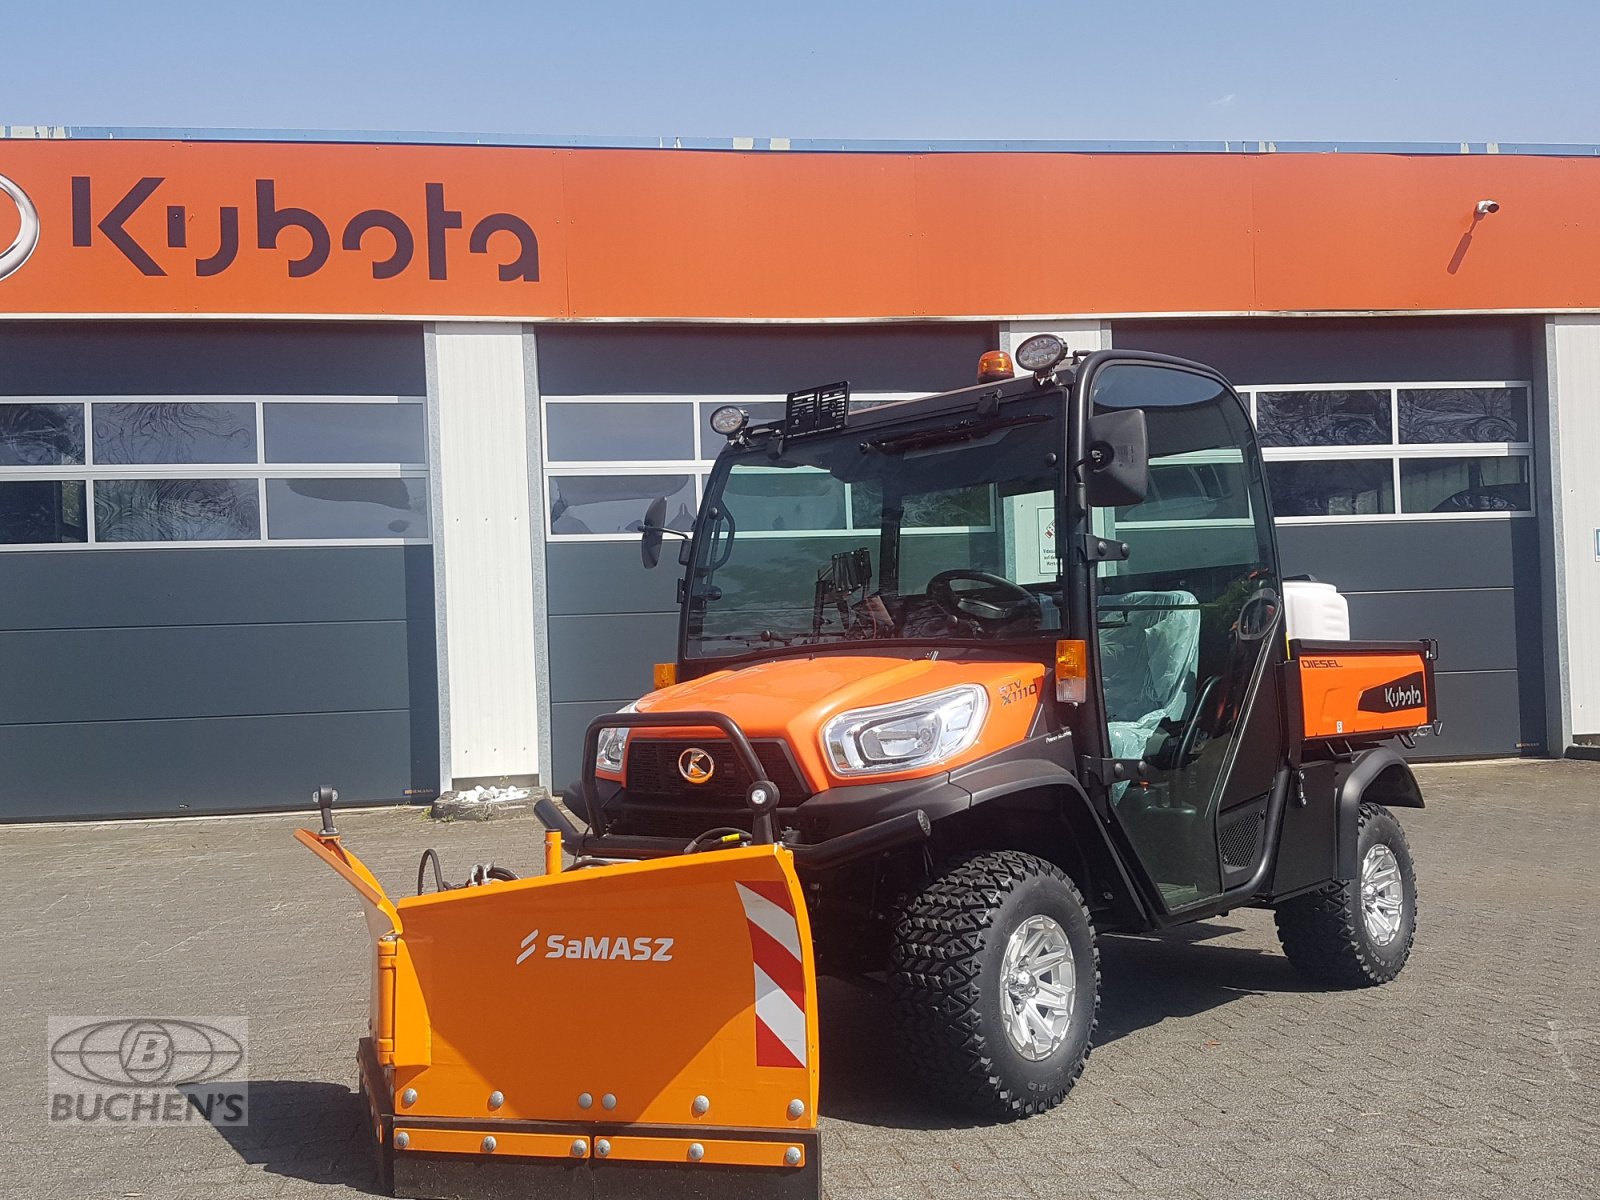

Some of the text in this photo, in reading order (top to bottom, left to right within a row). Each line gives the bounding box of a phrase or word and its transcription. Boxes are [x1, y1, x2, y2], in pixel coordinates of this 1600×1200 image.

[71, 175, 541, 283] Kubota
[1301, 659, 1343, 669] DIESEL
[1001, 683, 1037, 706] X1110
[1384, 685, 1421, 708] Kubota
[545, 934, 674, 962] SaMASZ
